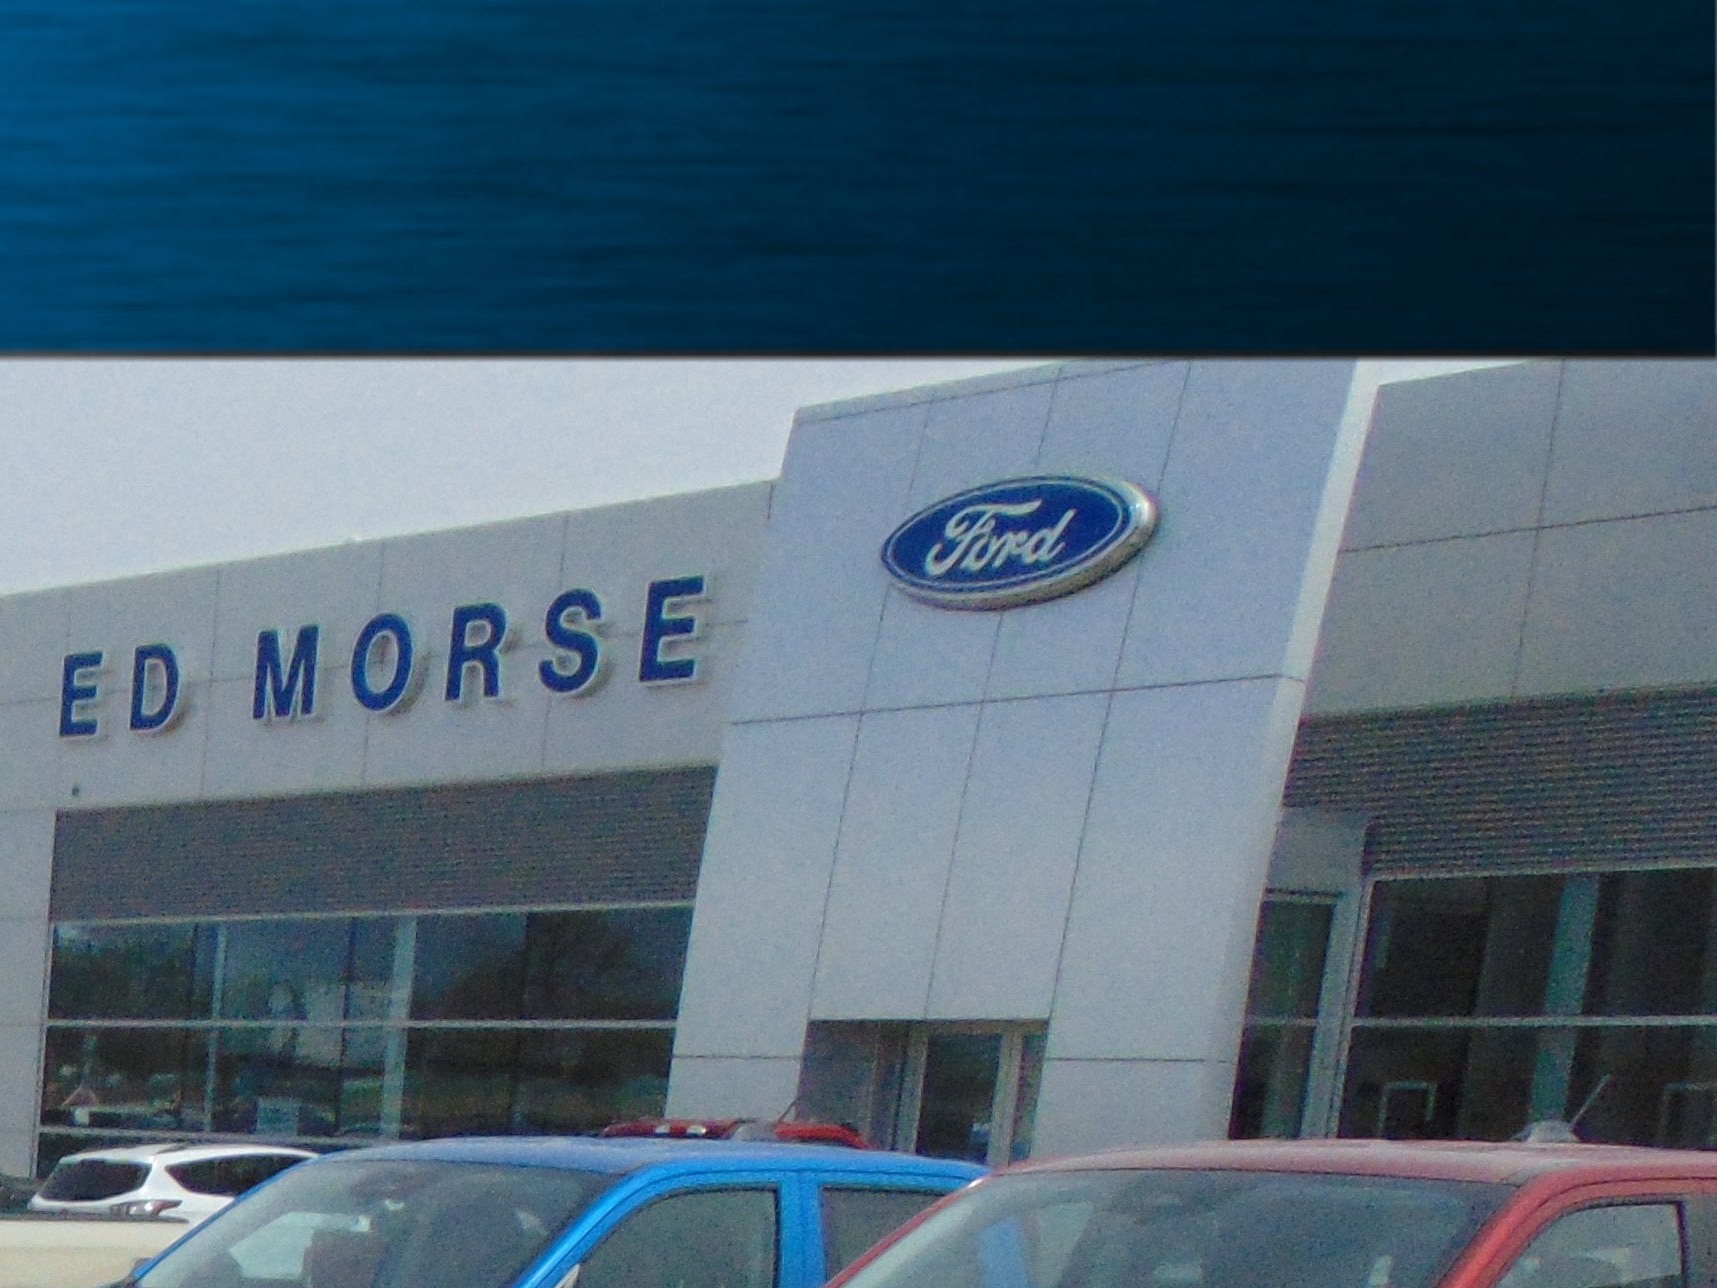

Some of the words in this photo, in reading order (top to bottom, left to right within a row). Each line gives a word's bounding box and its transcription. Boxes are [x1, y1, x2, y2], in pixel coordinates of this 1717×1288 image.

[922, 500, 1067, 576] Ford
[58, 644, 181, 738] ED
[251, 574, 707, 720] MORSE
